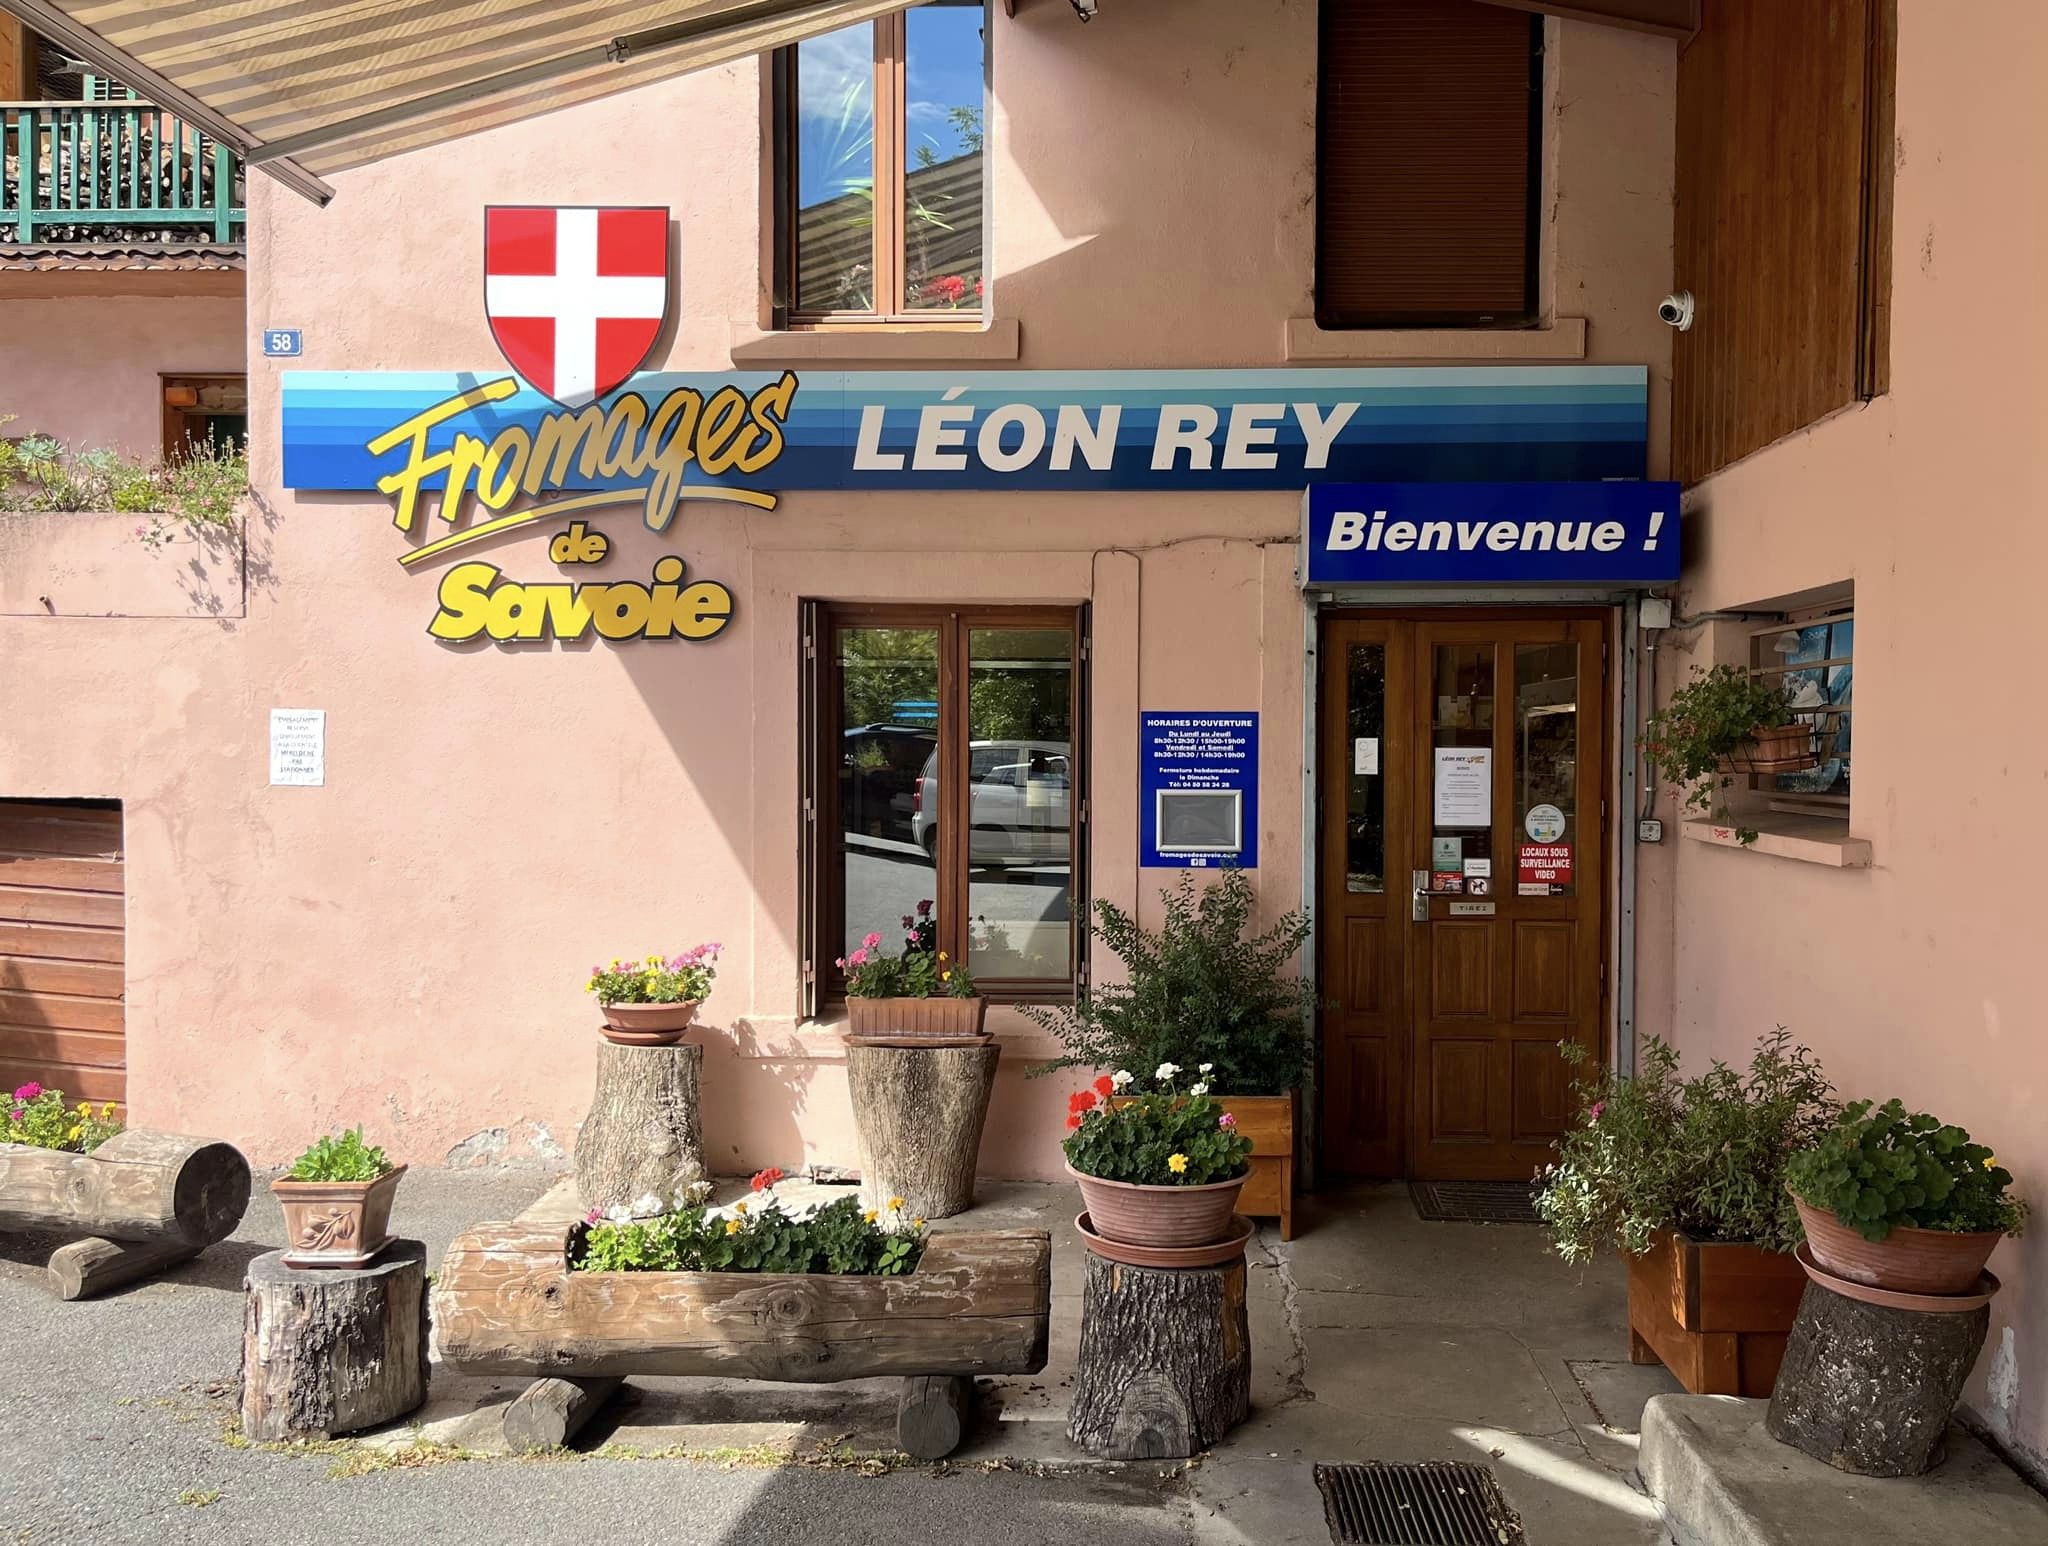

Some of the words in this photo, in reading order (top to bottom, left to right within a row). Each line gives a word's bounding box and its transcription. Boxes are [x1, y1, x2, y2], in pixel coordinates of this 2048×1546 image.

[272, 334, 292, 351] 58
[852, 385, 1123, 473] LÉON
[1151, 402, 1362, 470] REY
[366, 369, 799, 532] Fromages
[1326, 510, 1626, 552] Bienvenue
[1643, 511, 1665, 552] !
[548, 520, 609, 565] de
[427, 555, 738, 641] Savoie
[1147, 719, 1191, 727] HORAIRES
[1192, 719, 1253, 727] D'OUVERTURE
[1168, 730, 1179, 738] Du
[1180, 730, 1199, 738] Lundi
[1211, 730, 1232, 738] Jeudi
[1166, 744, 1197, 752] Vendredi
[1198, 744, 1206, 752] et
[1207, 744, 1234, 752] Samedi
[1521, 847, 1549, 857] LOCAUX
[1549, 847, 1569, 857] SOUS
[1520, 858, 1571, 869] SURVEILLANCE
[1534, 869, 1556, 879] VIDEO
